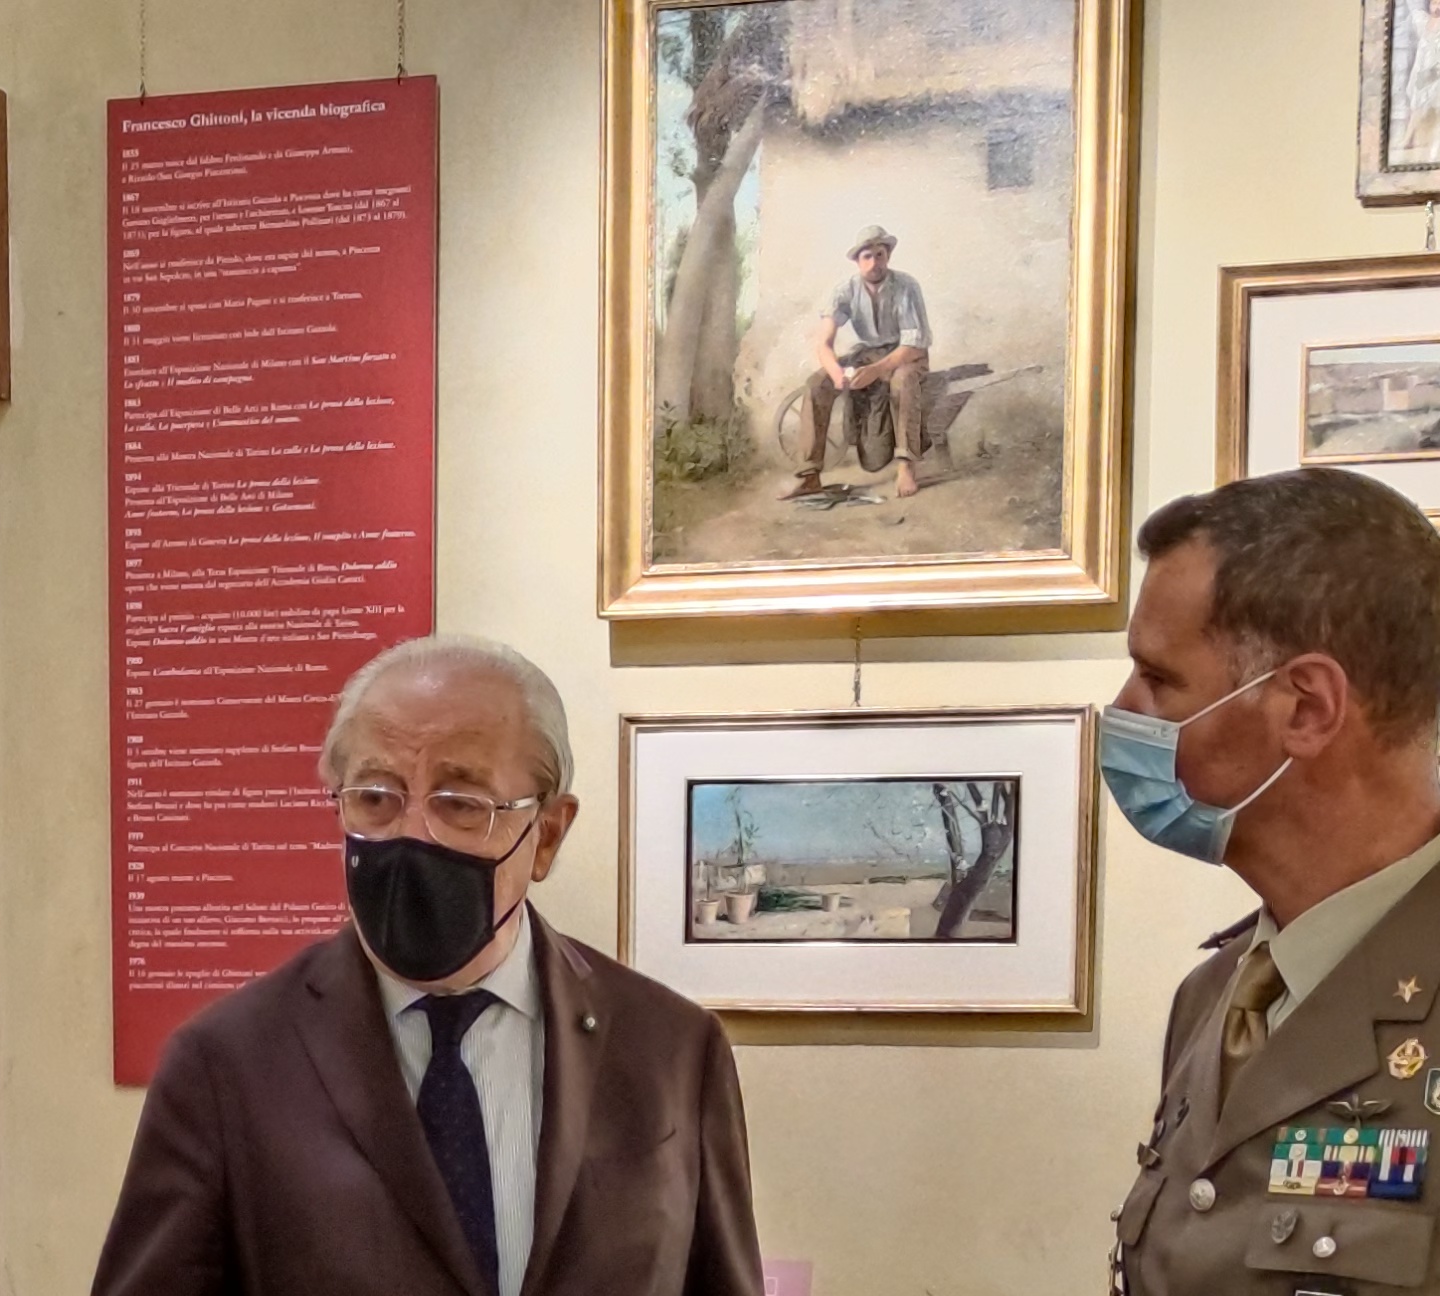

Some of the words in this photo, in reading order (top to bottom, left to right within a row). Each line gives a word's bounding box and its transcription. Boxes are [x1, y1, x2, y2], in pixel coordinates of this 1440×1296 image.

[122, 118, 186, 133] Francesco
[189, 111, 248, 128] Ghittoni,
[251, 108, 262, 123] la
[266, 104, 315, 121] vicenda
[319, 99, 385, 119] biografica
